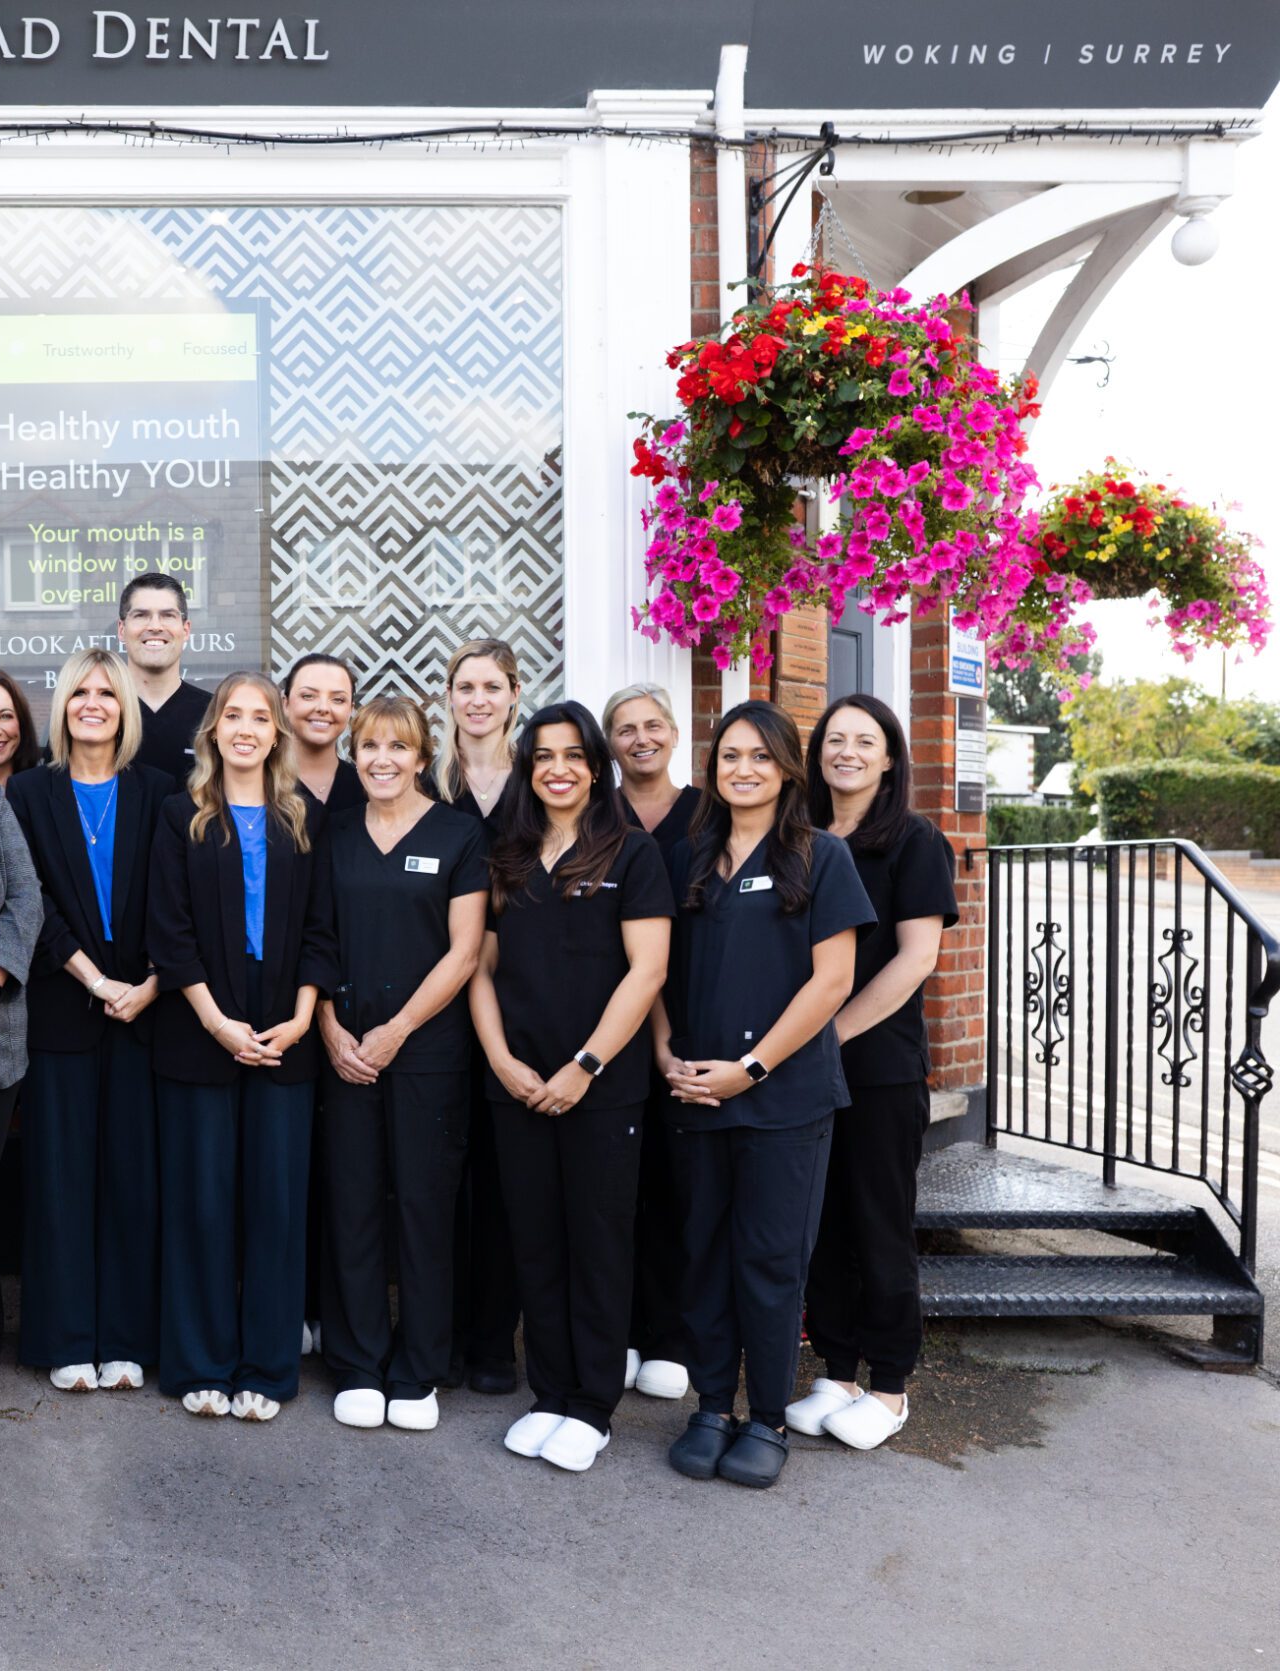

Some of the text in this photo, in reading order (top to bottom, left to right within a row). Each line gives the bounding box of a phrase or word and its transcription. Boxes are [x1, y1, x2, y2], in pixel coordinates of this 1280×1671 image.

[92, 10, 330, 61] DENTAL
[863, 44, 1016, 65] WOKING
[1078, 43, 1231, 64] SURREY
[42, 342, 135, 360] Trustworthy
[183, 341, 248, 356] Focused
[132, 409, 240, 440] mouth
[1, 458, 232, 497] Healthy YOU!
[28, 521, 205, 543] Your mouth is a
[28, 552, 206, 577] window to your
[41, 581, 116, 603] overall
[71, 634, 127, 656] AFTE
